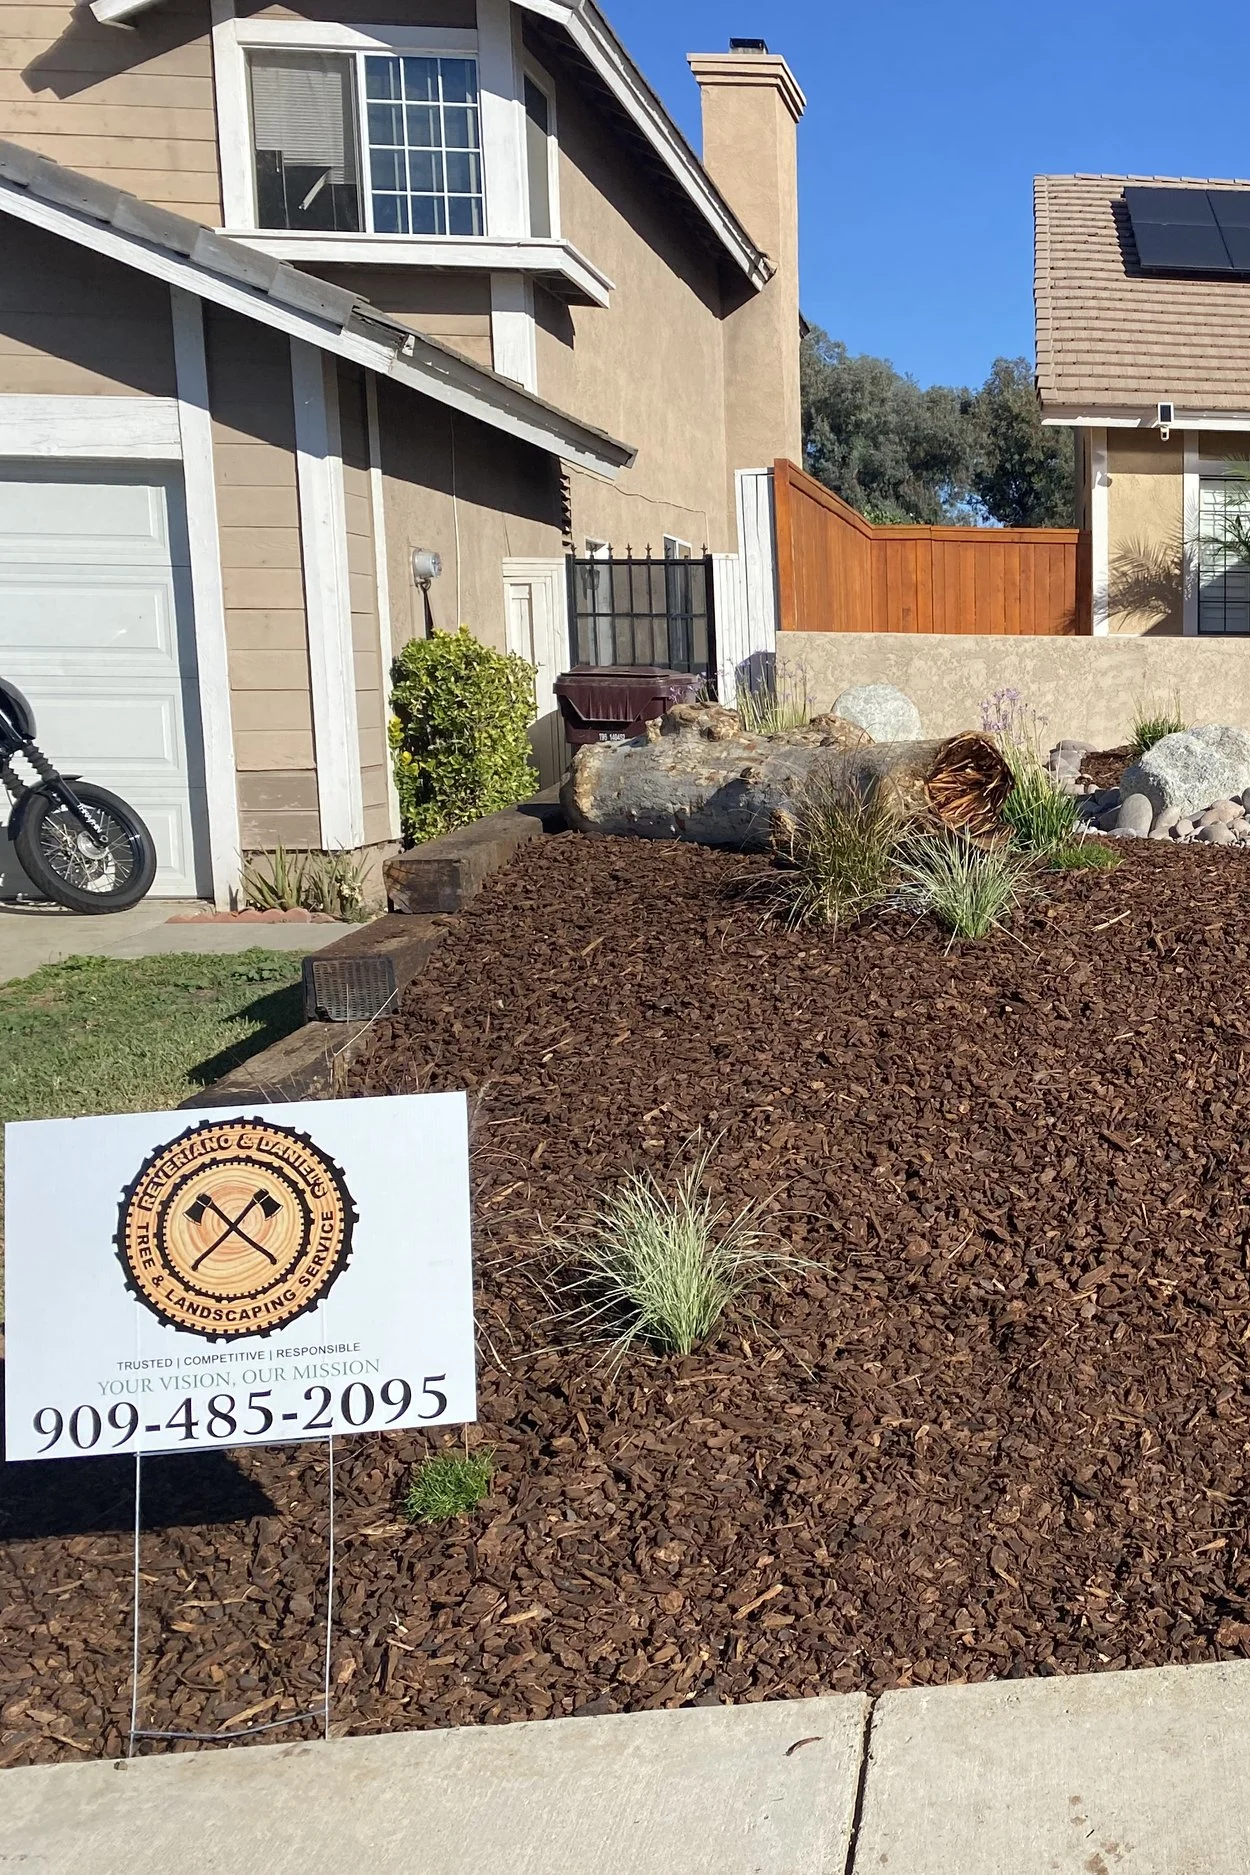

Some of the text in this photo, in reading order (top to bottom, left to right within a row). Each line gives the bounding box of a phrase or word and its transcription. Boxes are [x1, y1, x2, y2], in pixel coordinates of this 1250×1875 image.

[137, 1133, 328, 1211] REVERIANO & DANIEL'S
[136, 1210, 333, 1322] TREE & LANDSCAPING SERVICE
[98, 1358, 381, 1397] YOUR VISION, OUR MISSION
[117, 1342, 361, 1371] TRUSTED COMPETITIVE RESPONSIBLE
[33, 1373, 448, 1453] 909-485-2095
